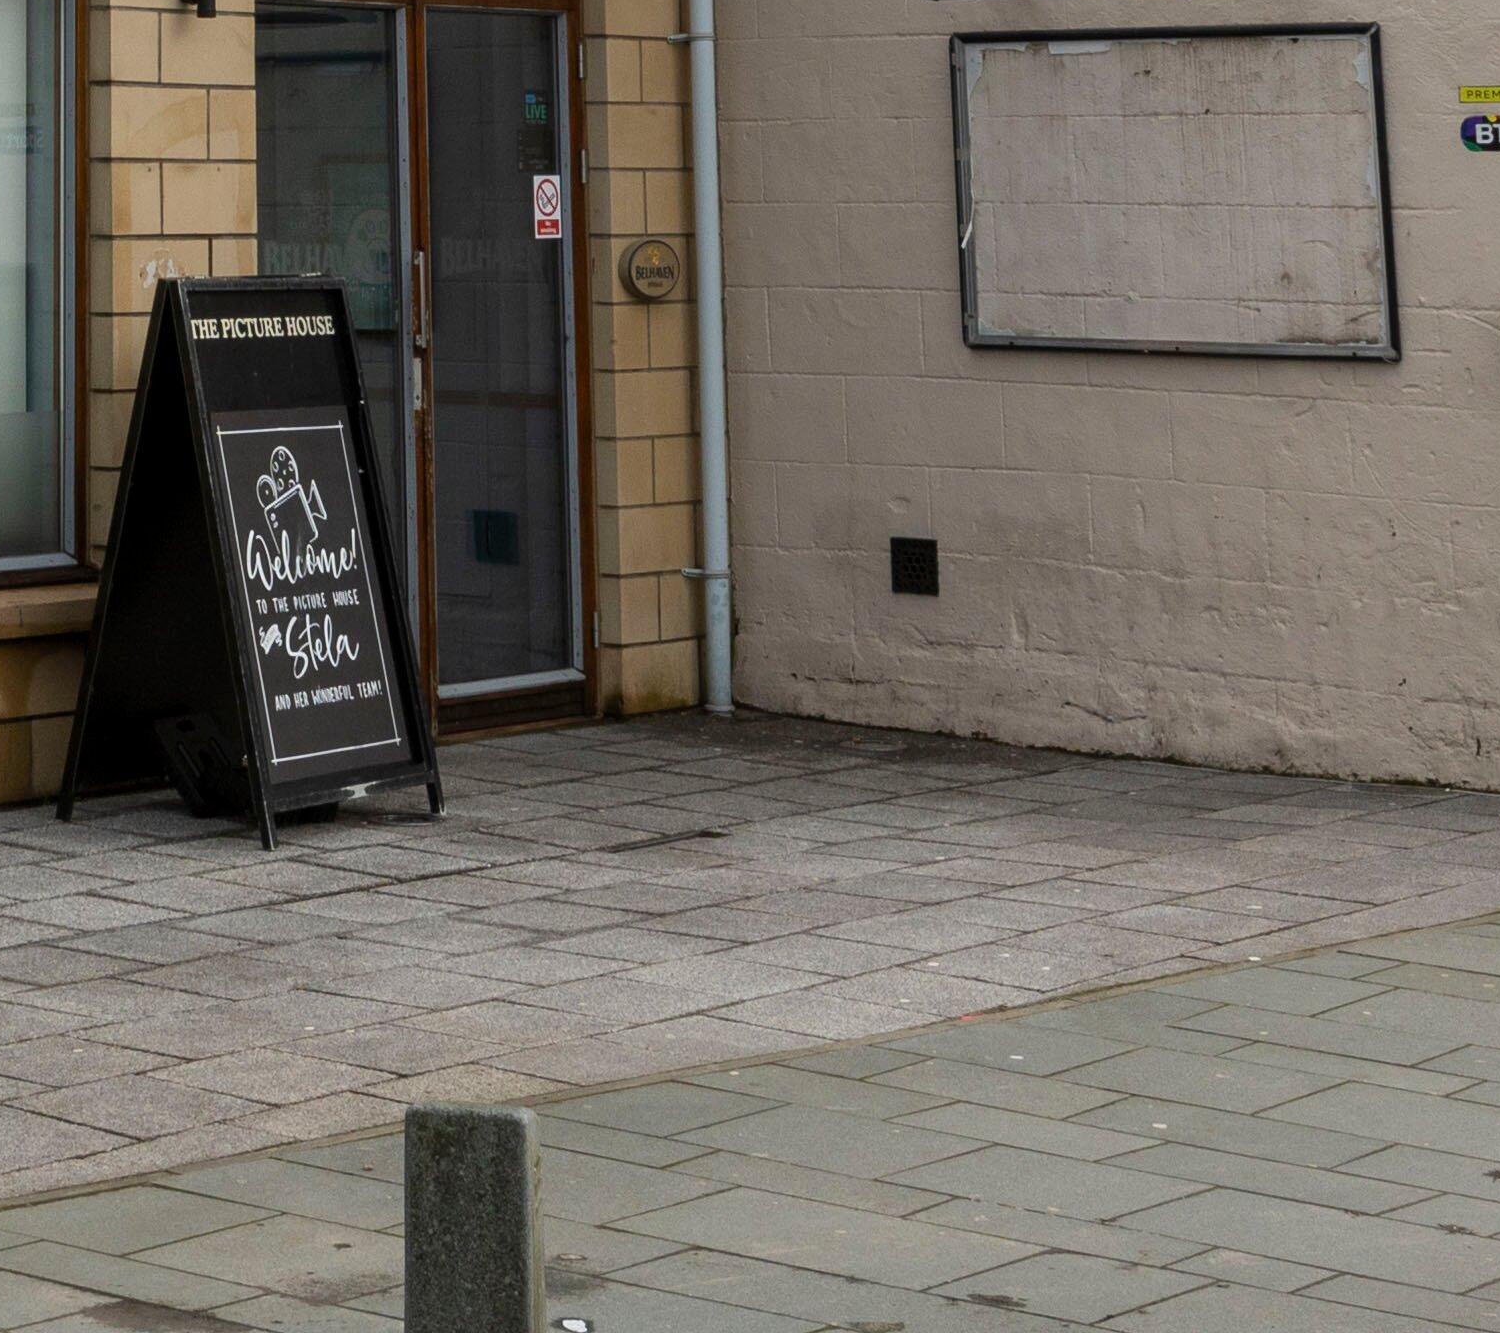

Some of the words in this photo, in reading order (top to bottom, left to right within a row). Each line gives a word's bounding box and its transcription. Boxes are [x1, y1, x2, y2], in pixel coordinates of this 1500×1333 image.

[525, 103, 548, 119] LIVE
[635, 264, 675, 281] BELHAVEN
[190, 319, 220, 340] THE
[221, 317, 284, 339] PICTURE
[285, 315, 335, 337] HOUSE
[246, 528, 358, 591] Welcome!
[256, 599, 268, 615] TO
[272, 596, 289, 613] THE
[293, 592, 327, 611] PICTURE
[332, 588, 360, 606] HOUSE
[285, 614, 359, 679] Stela
[275, 695, 290, 711] AND
[294, 691, 309, 708] HER
[312, 685, 355, 705] WONDERFUL
[357, 680, 383, 699] TEAM!
